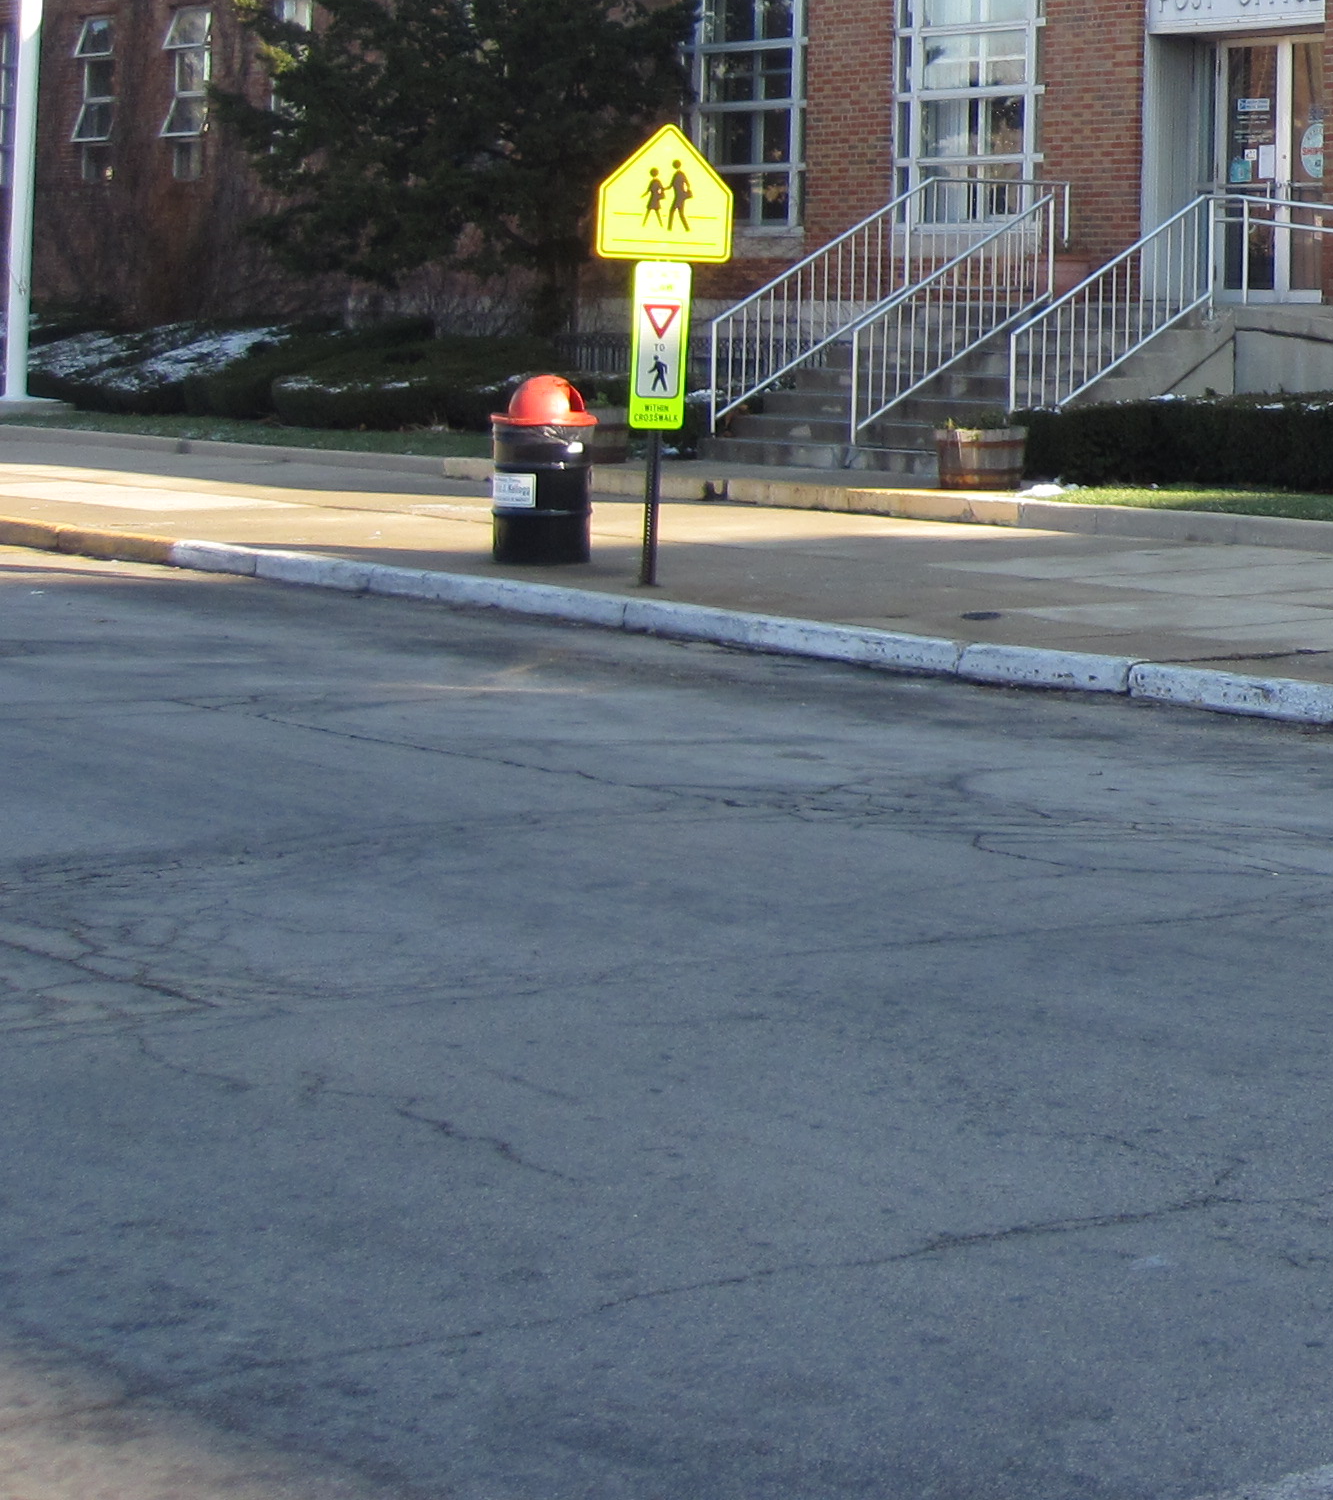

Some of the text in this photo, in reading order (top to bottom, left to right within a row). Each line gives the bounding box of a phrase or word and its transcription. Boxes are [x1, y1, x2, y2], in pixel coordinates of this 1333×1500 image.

[654, 343, 665, 352] TO
[644, 404, 669, 412] WITHIN
[633, 412, 679, 422] CROSSWALK
